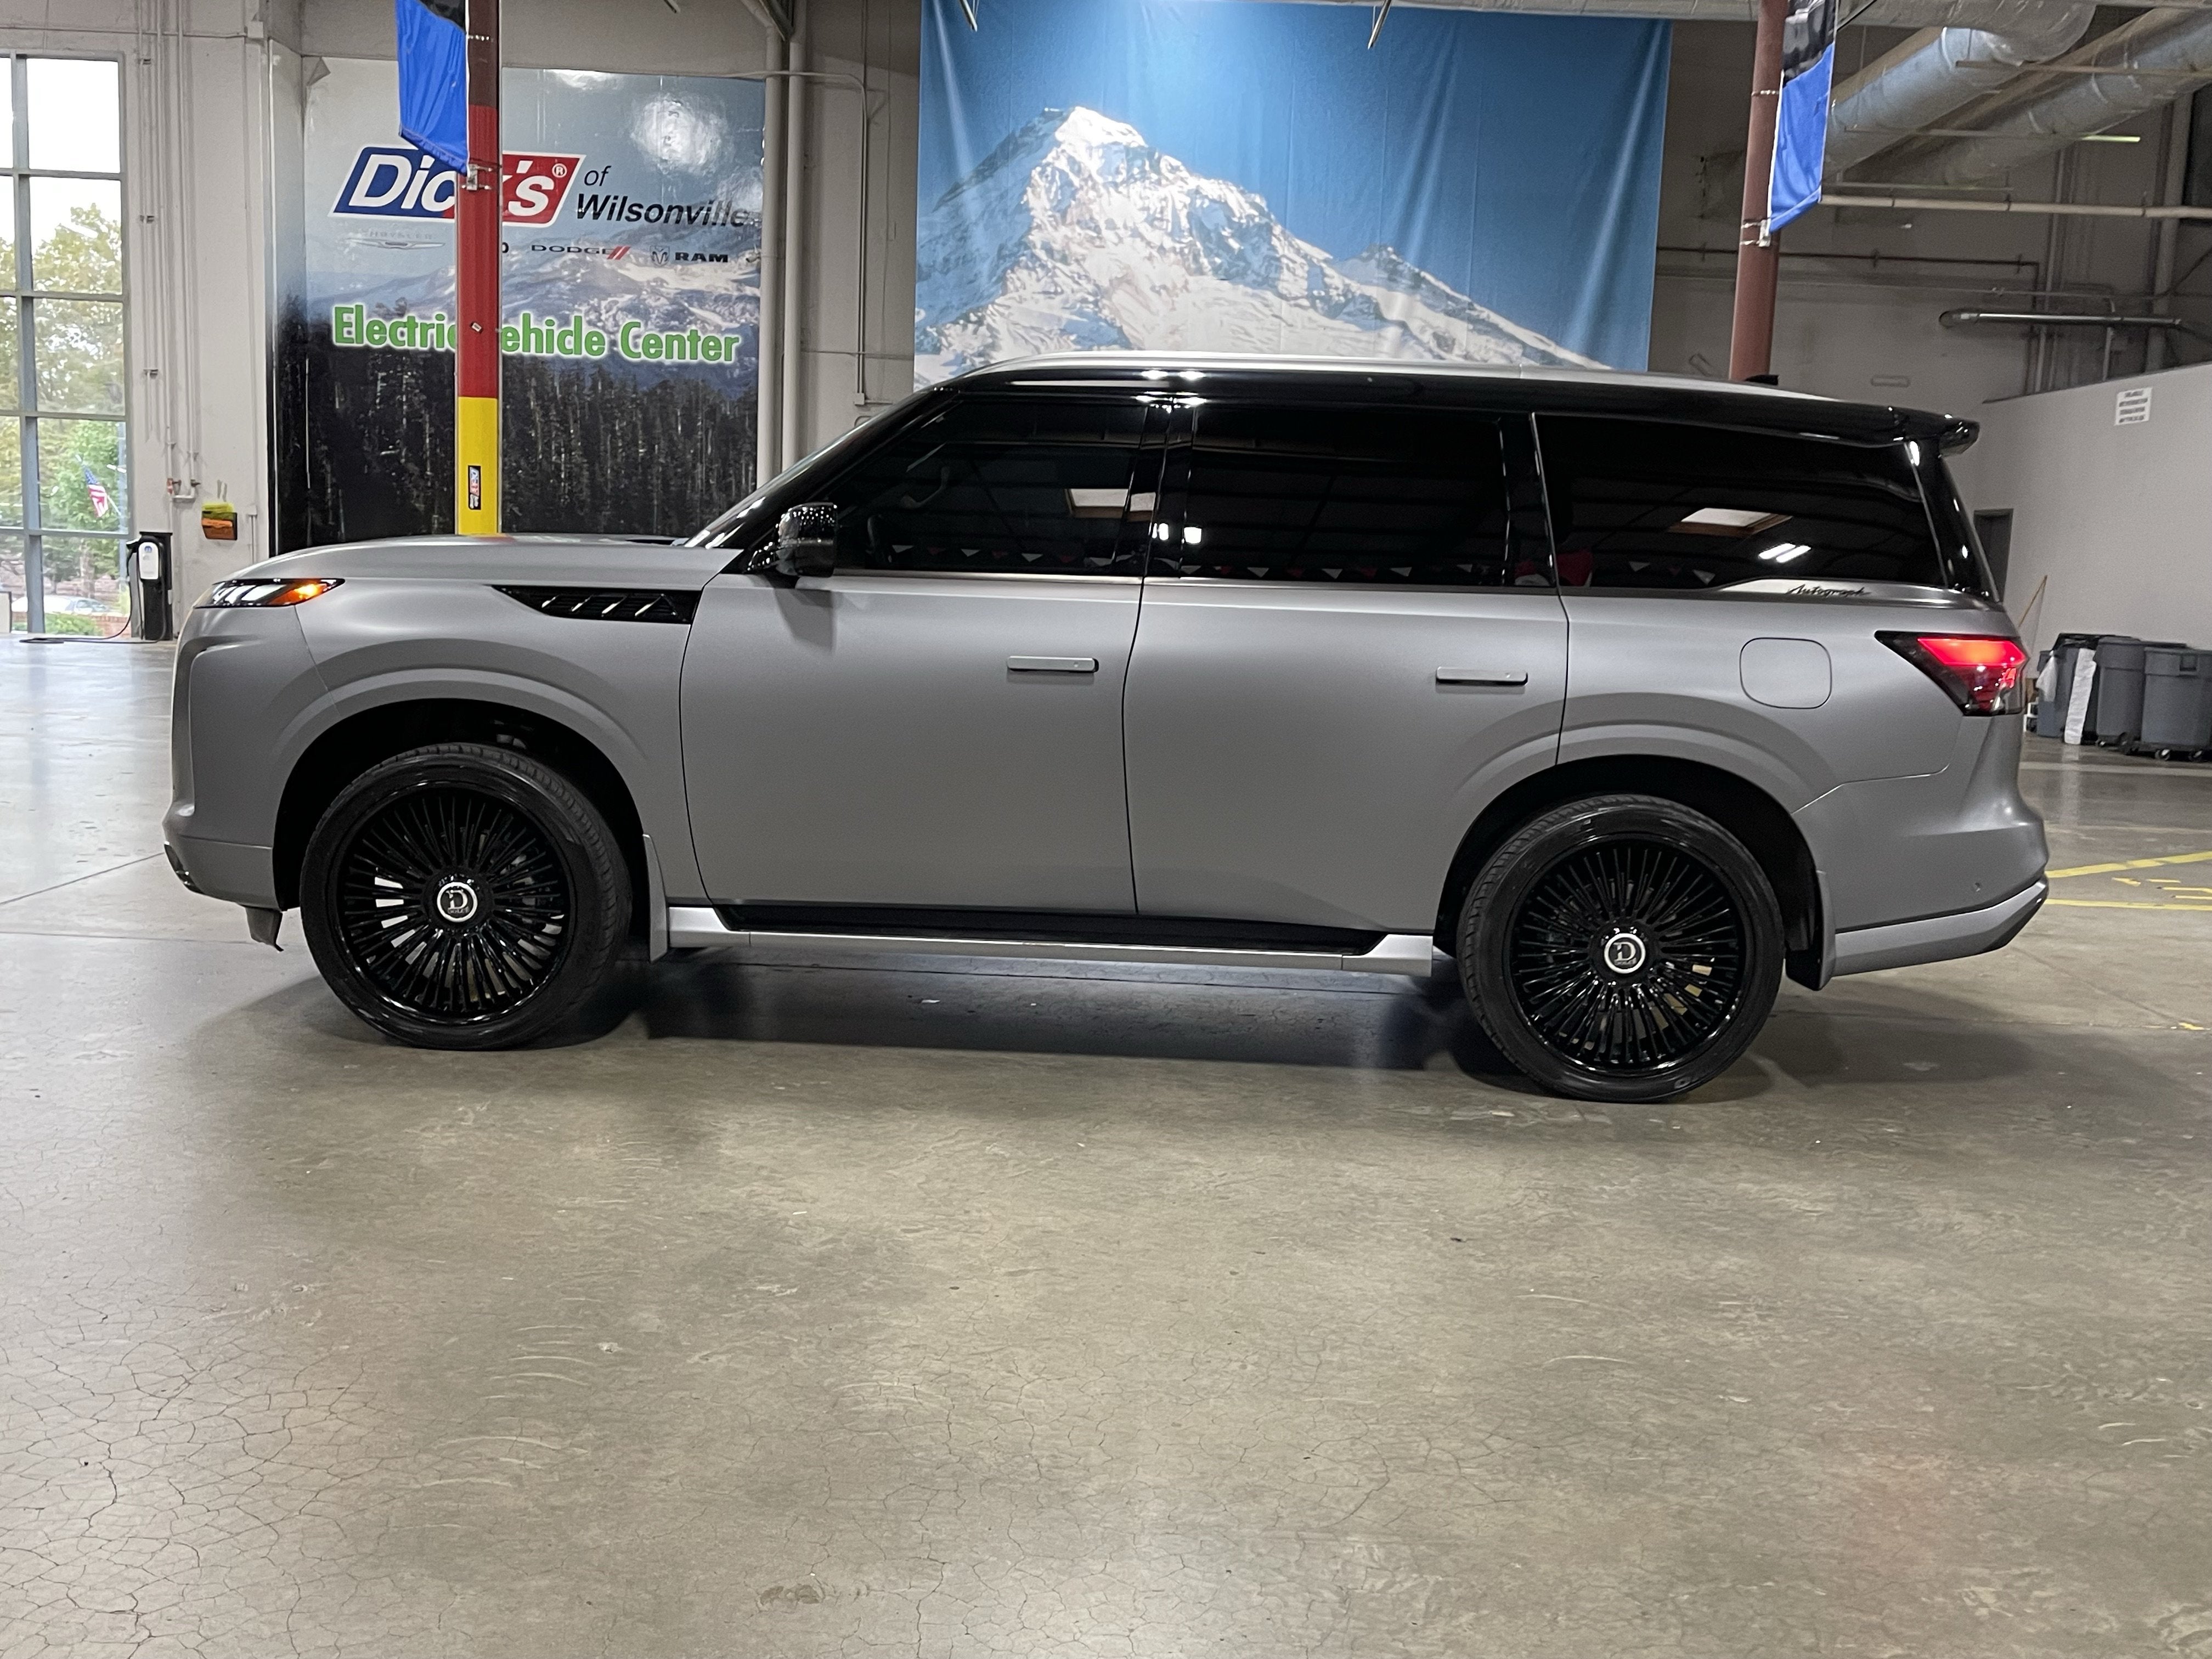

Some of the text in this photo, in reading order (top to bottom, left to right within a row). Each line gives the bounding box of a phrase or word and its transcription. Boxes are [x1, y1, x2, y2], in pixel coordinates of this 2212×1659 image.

[349, 154, 555, 217] Dic's
[584, 166, 612, 187] of
[577, 193, 749, 227] Wilsonville
[531, 245, 616, 255] DODGE
[675, 252, 729, 263] RAM
[501, 313, 606, 356] ehicle
[620, 321, 739, 362] Center
[445, 889, 469, 910] D
[1613, 941, 1637, 961] D
